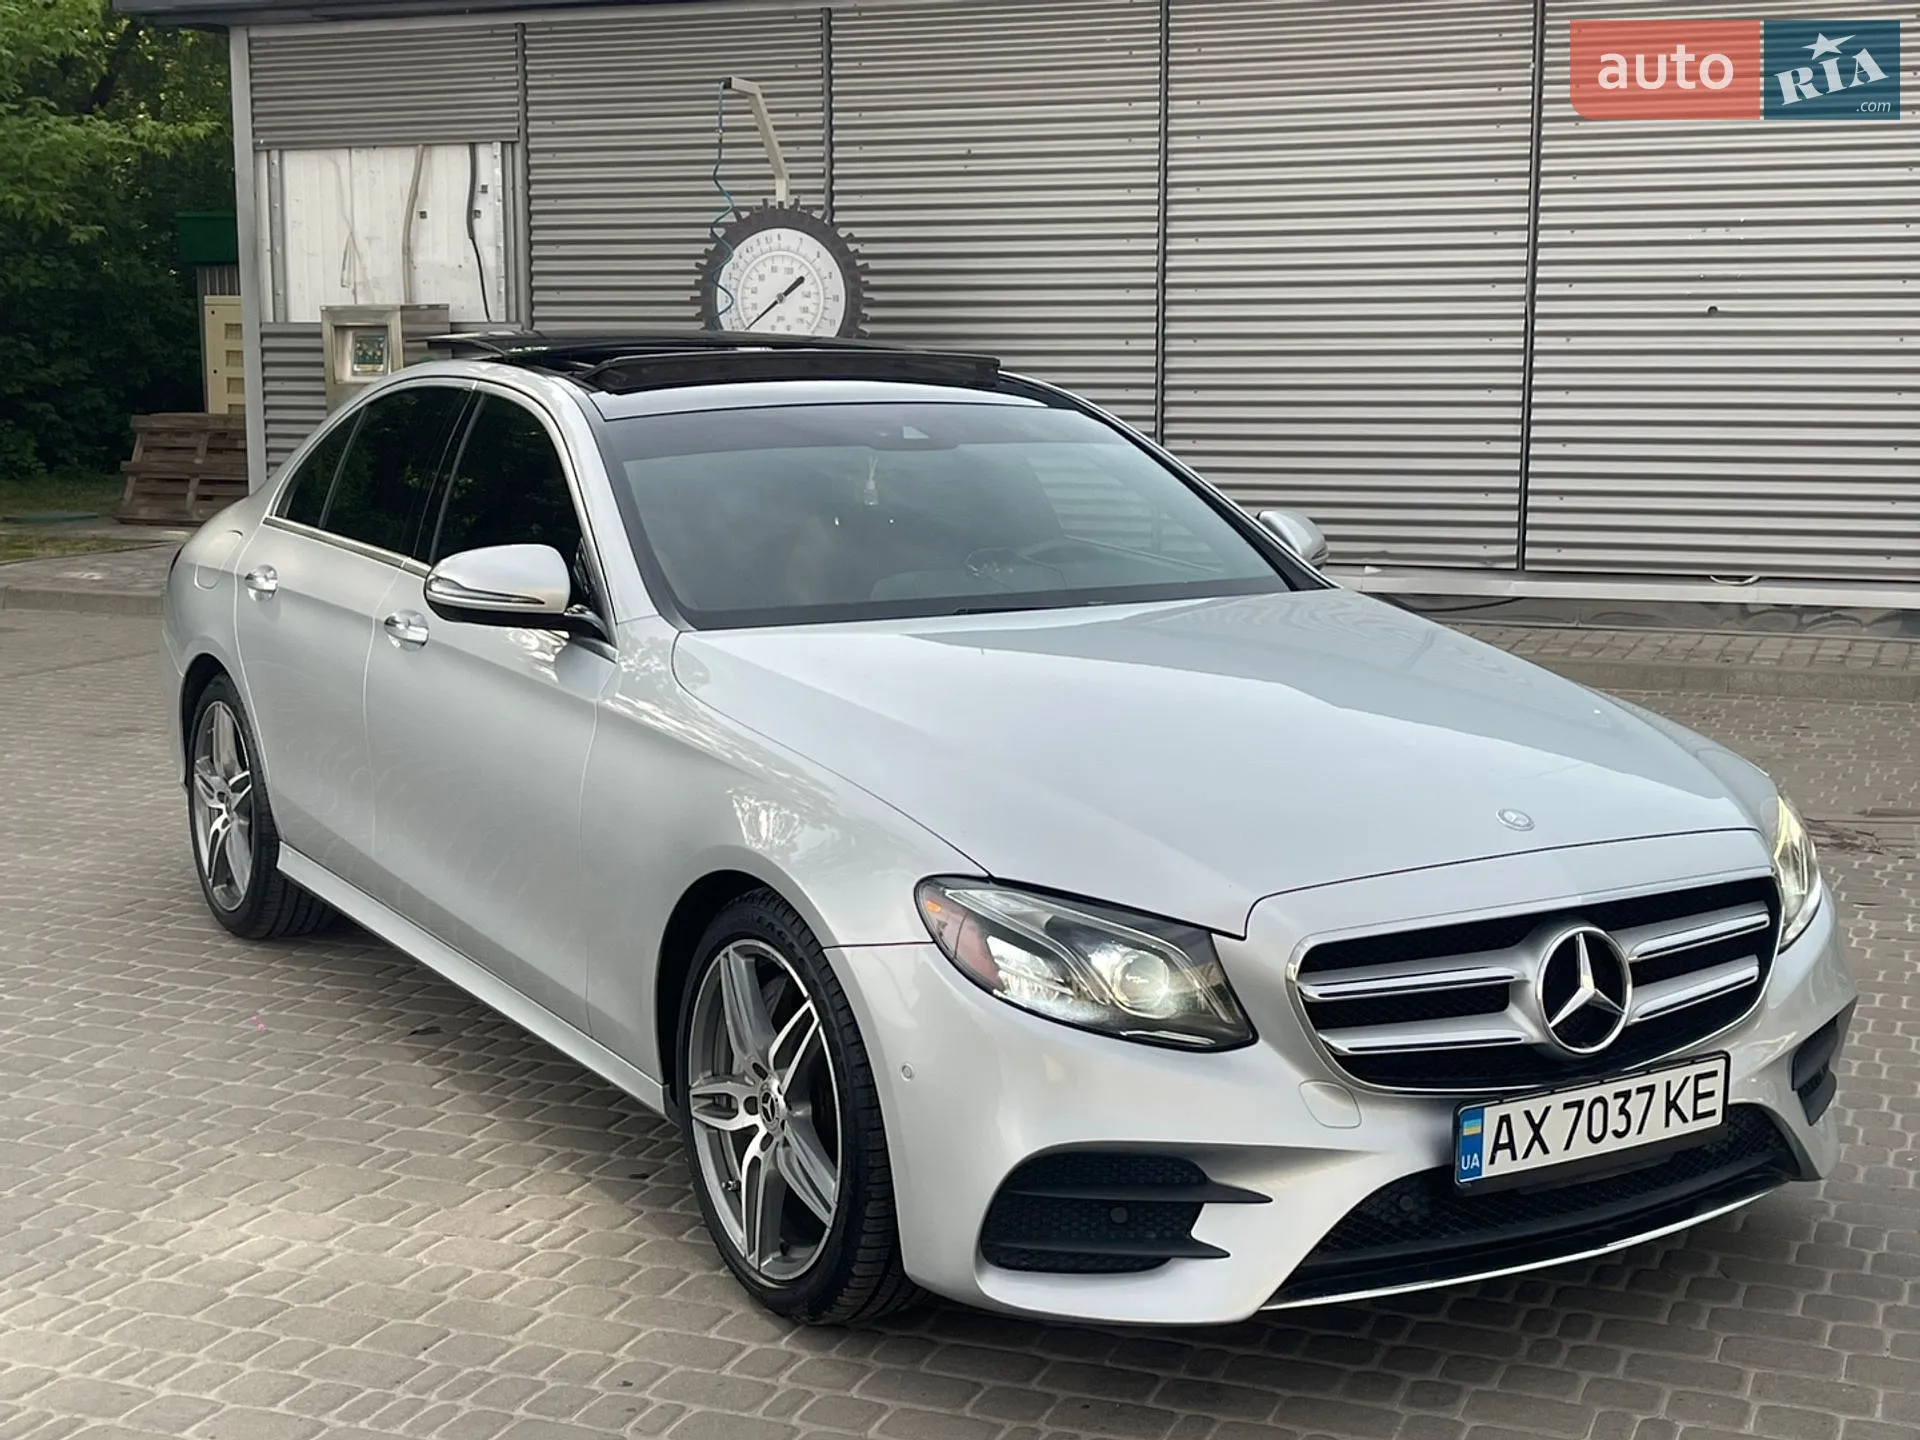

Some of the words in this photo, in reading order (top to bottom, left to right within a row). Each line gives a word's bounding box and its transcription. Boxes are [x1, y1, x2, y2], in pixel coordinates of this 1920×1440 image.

[1488, 1105, 1552, 1165] AX
[1563, 1084, 1656, 1151] 7037
[1664, 1070, 1719, 1128] KE
[1461, 1152, 1480, 1171] UA
